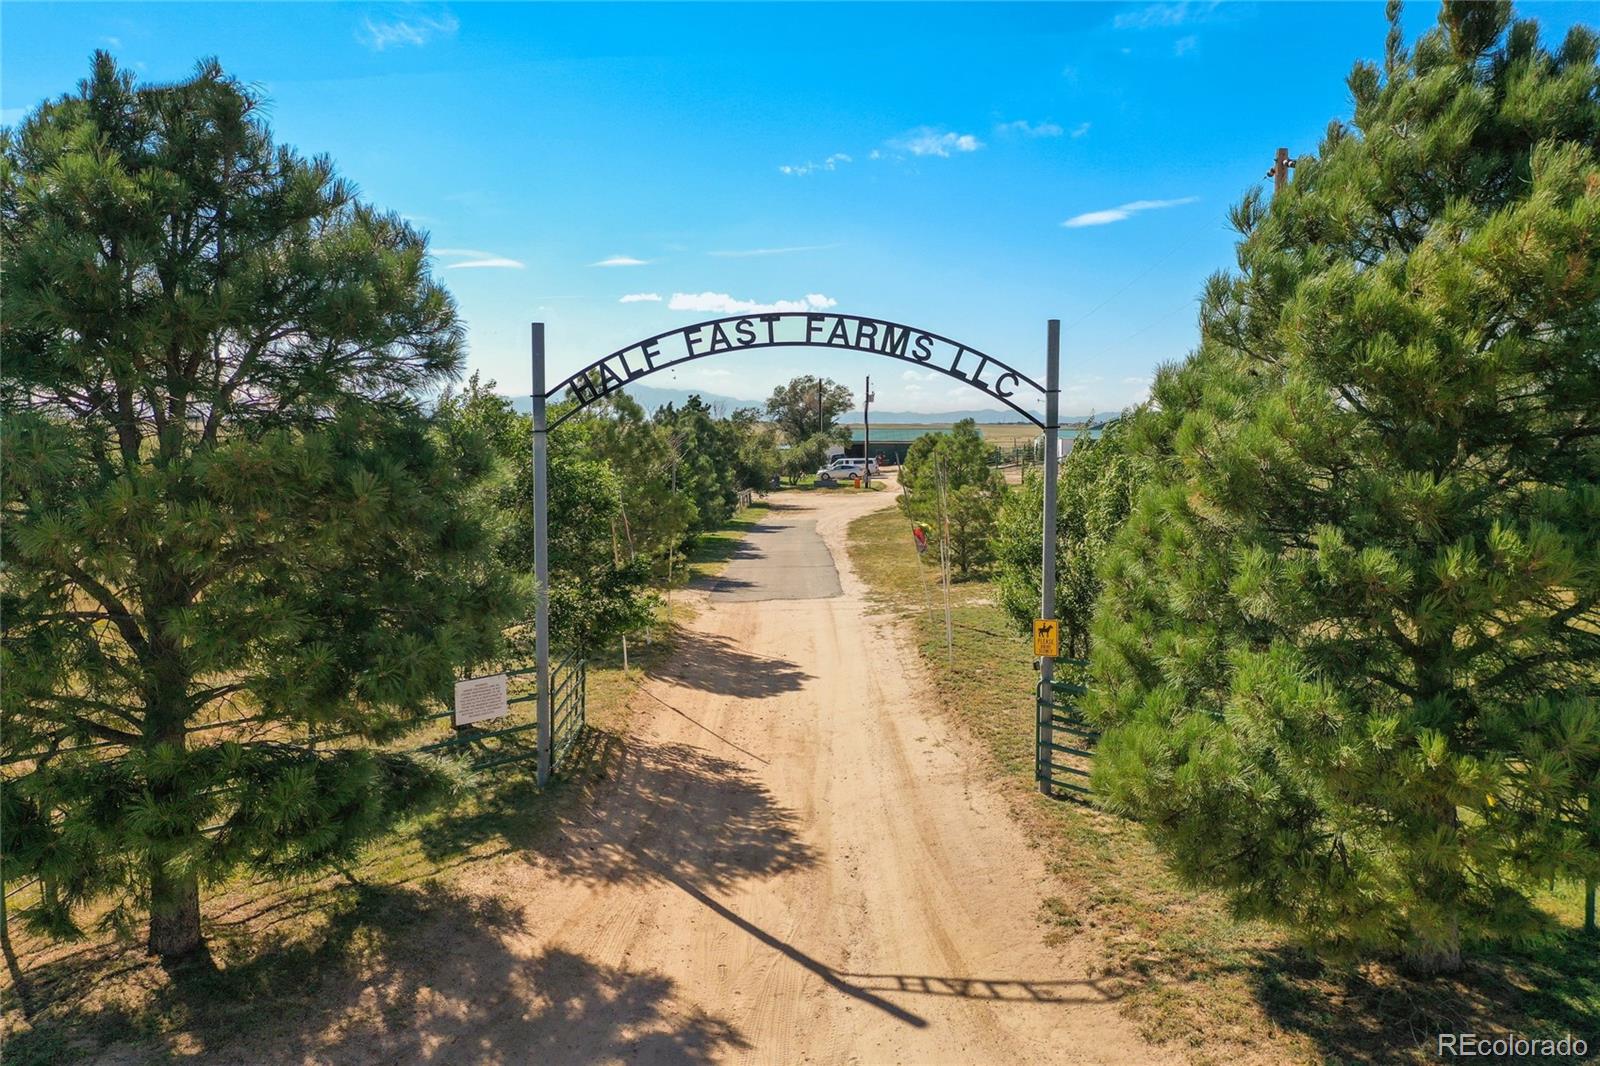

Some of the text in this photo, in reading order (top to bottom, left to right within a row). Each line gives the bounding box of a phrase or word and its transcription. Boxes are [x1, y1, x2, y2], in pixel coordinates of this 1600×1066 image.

[568, 315, 1019, 406] HALF FAST FARMS LLC
